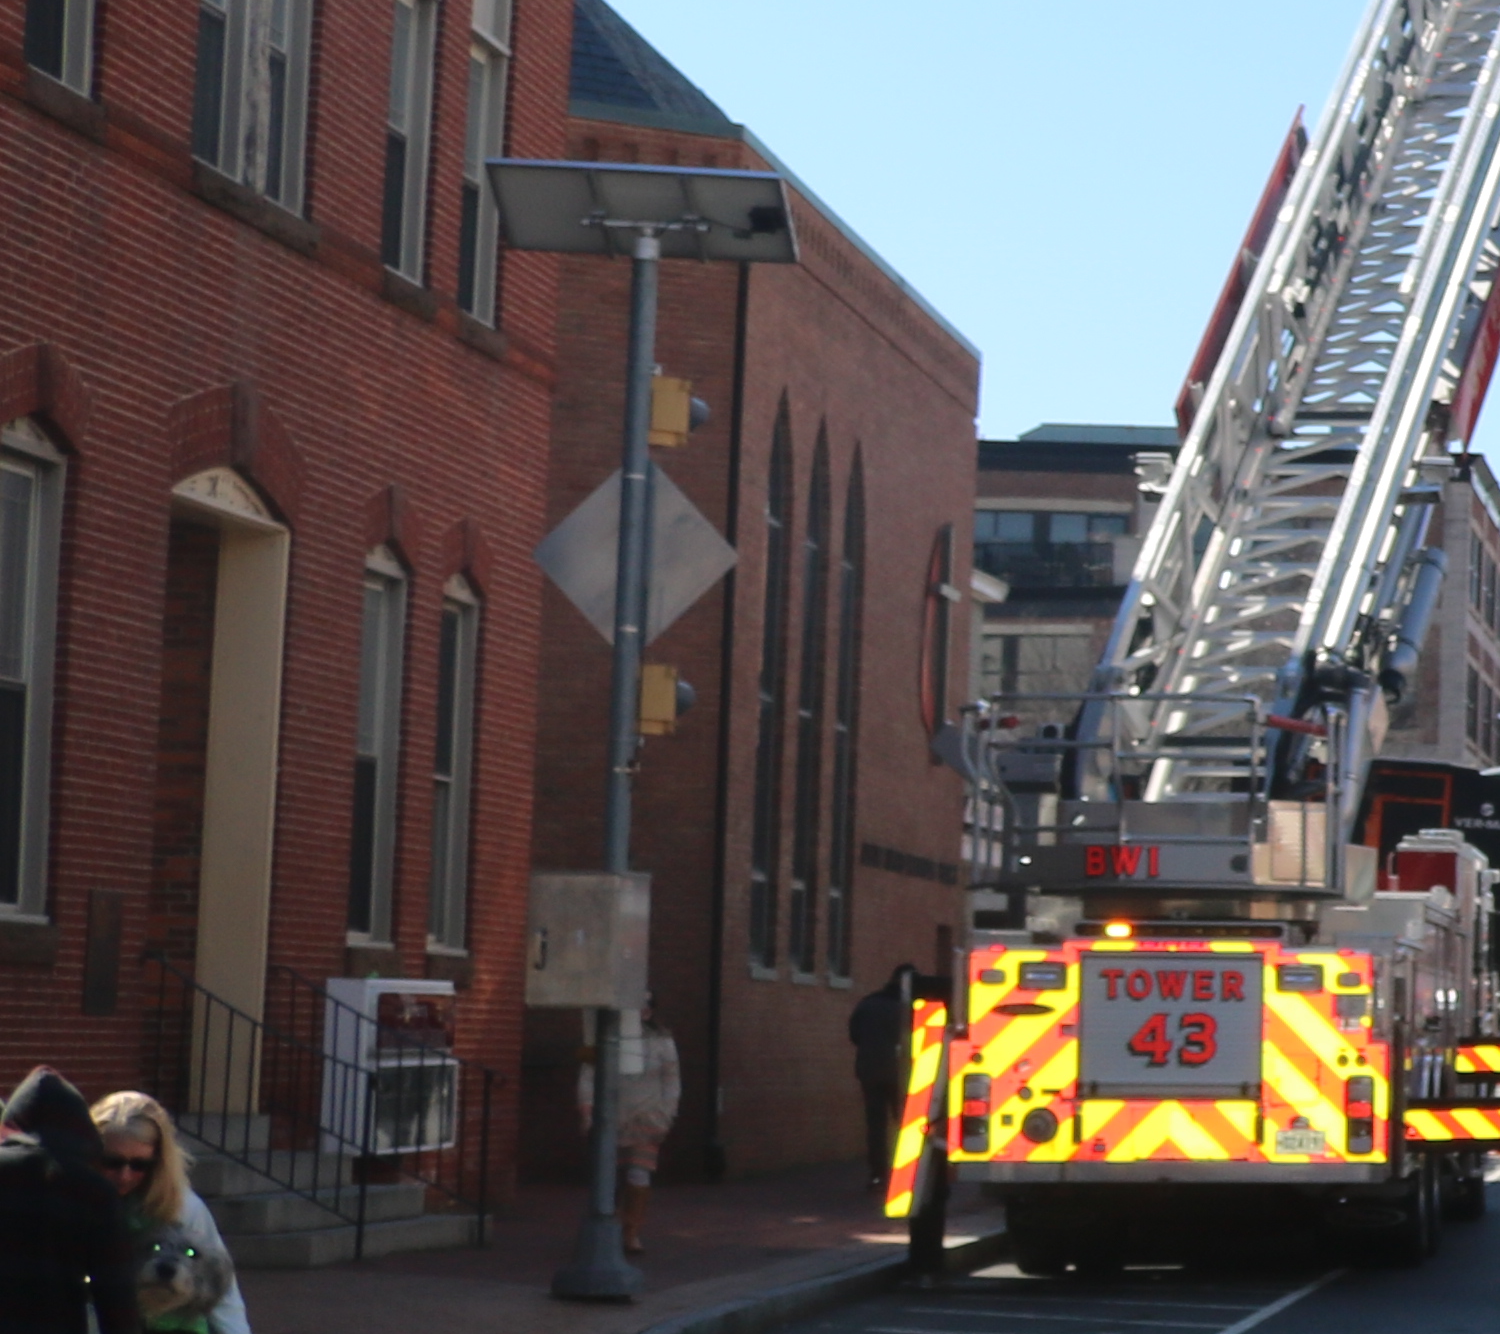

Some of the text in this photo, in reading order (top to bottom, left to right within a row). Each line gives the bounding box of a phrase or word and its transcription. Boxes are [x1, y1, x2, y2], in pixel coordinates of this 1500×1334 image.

[1085, 844, 1161, 877] BWI
[1100, 968, 1246, 1001] TOWER
[1128, 1011, 1218, 1067] 43
